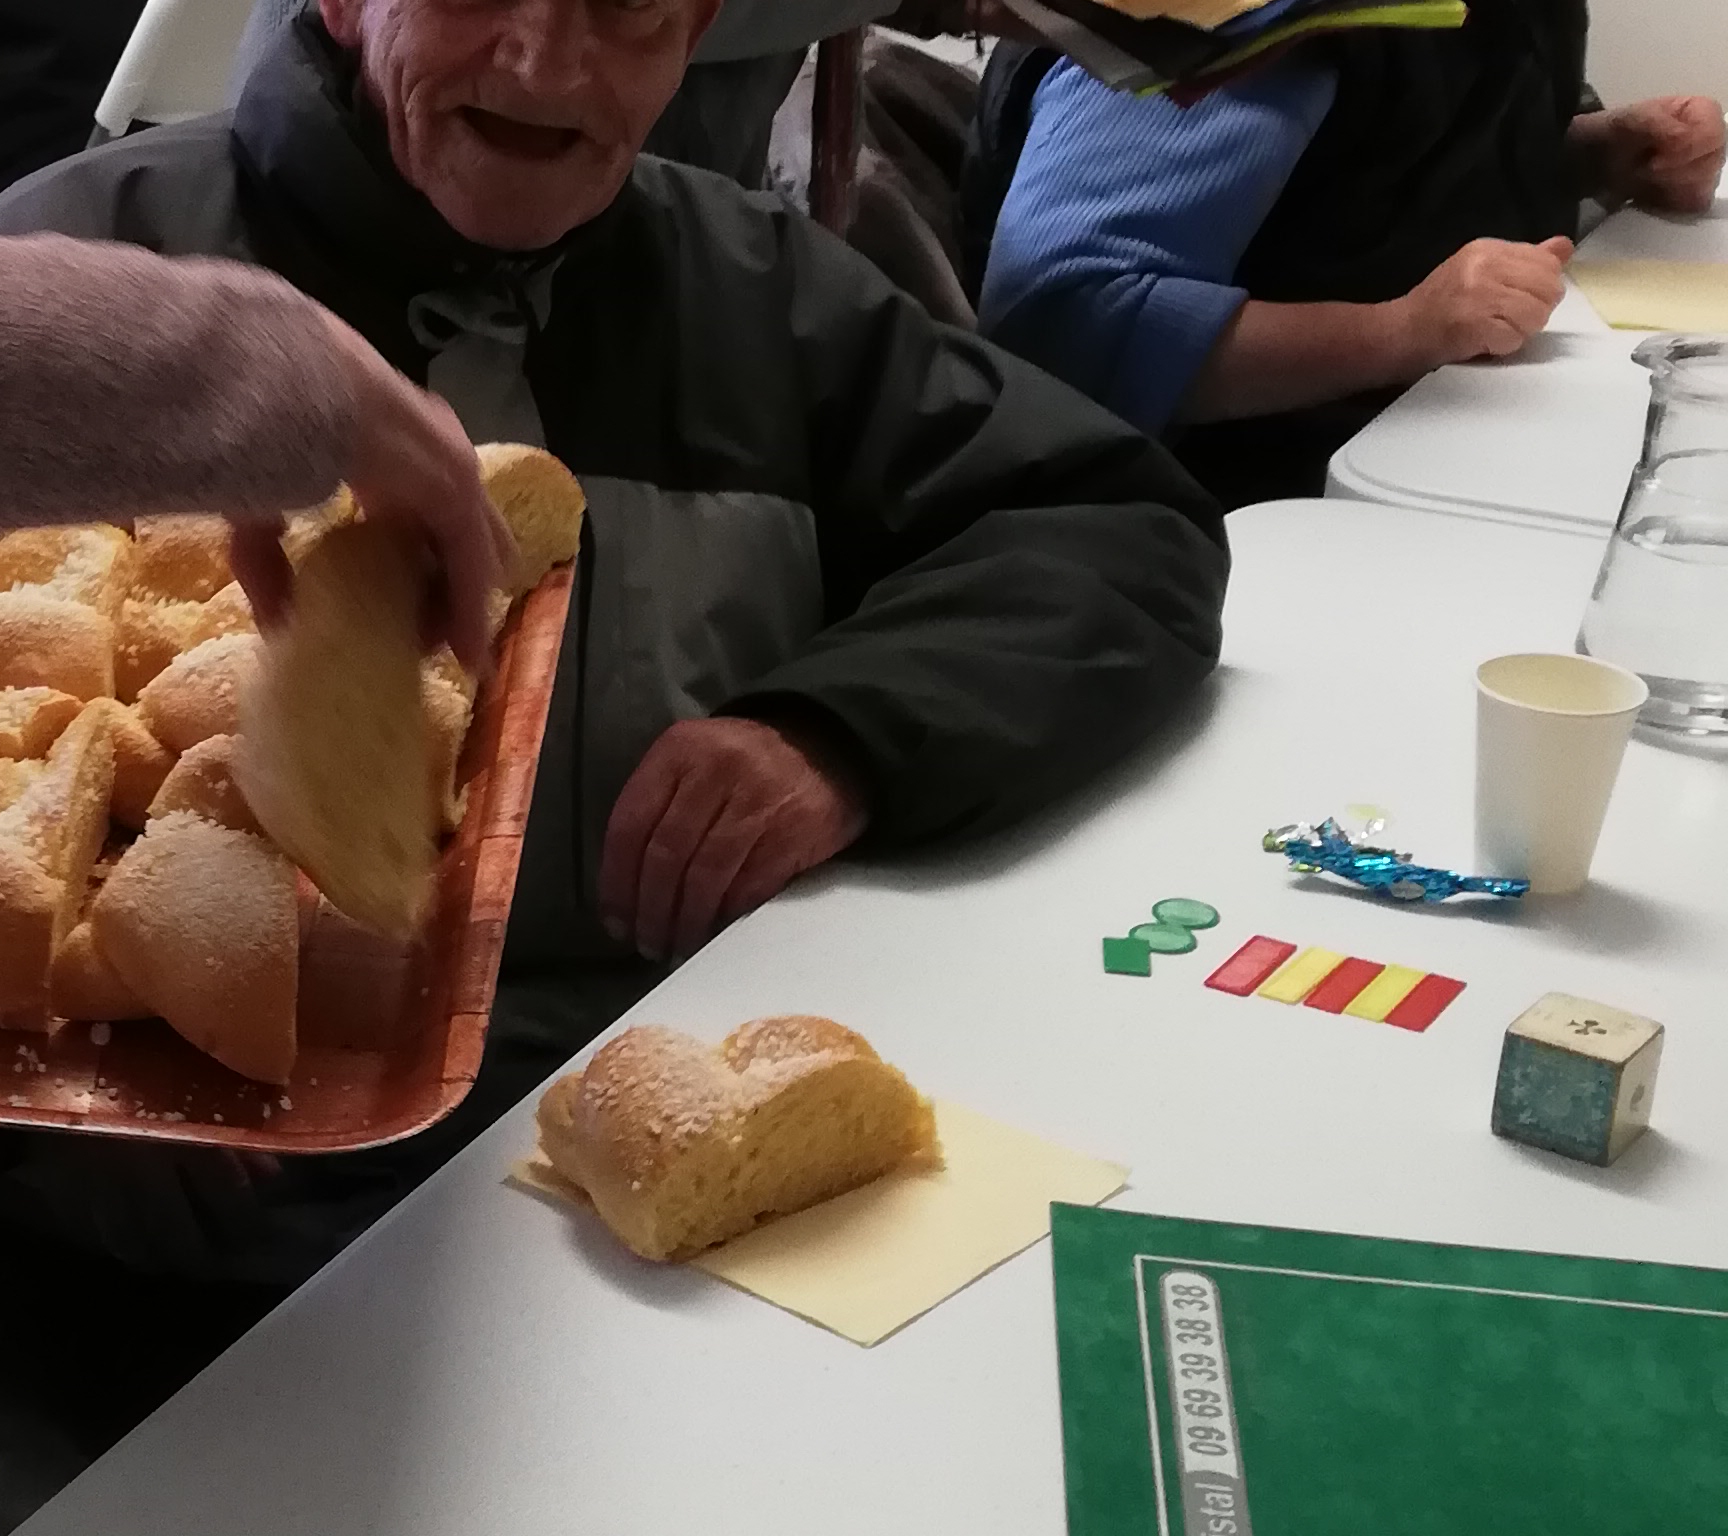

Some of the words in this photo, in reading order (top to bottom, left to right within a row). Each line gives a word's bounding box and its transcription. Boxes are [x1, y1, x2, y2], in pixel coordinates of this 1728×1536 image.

[1171, 1284, 1210, 1312] 38
[1174, 1319, 1214, 1346] 38
[1178, 1353, 1219, 1382] 39
[1183, 1389, 1223, 1419] 69
[1187, 1425, 1228, 1457] 09
